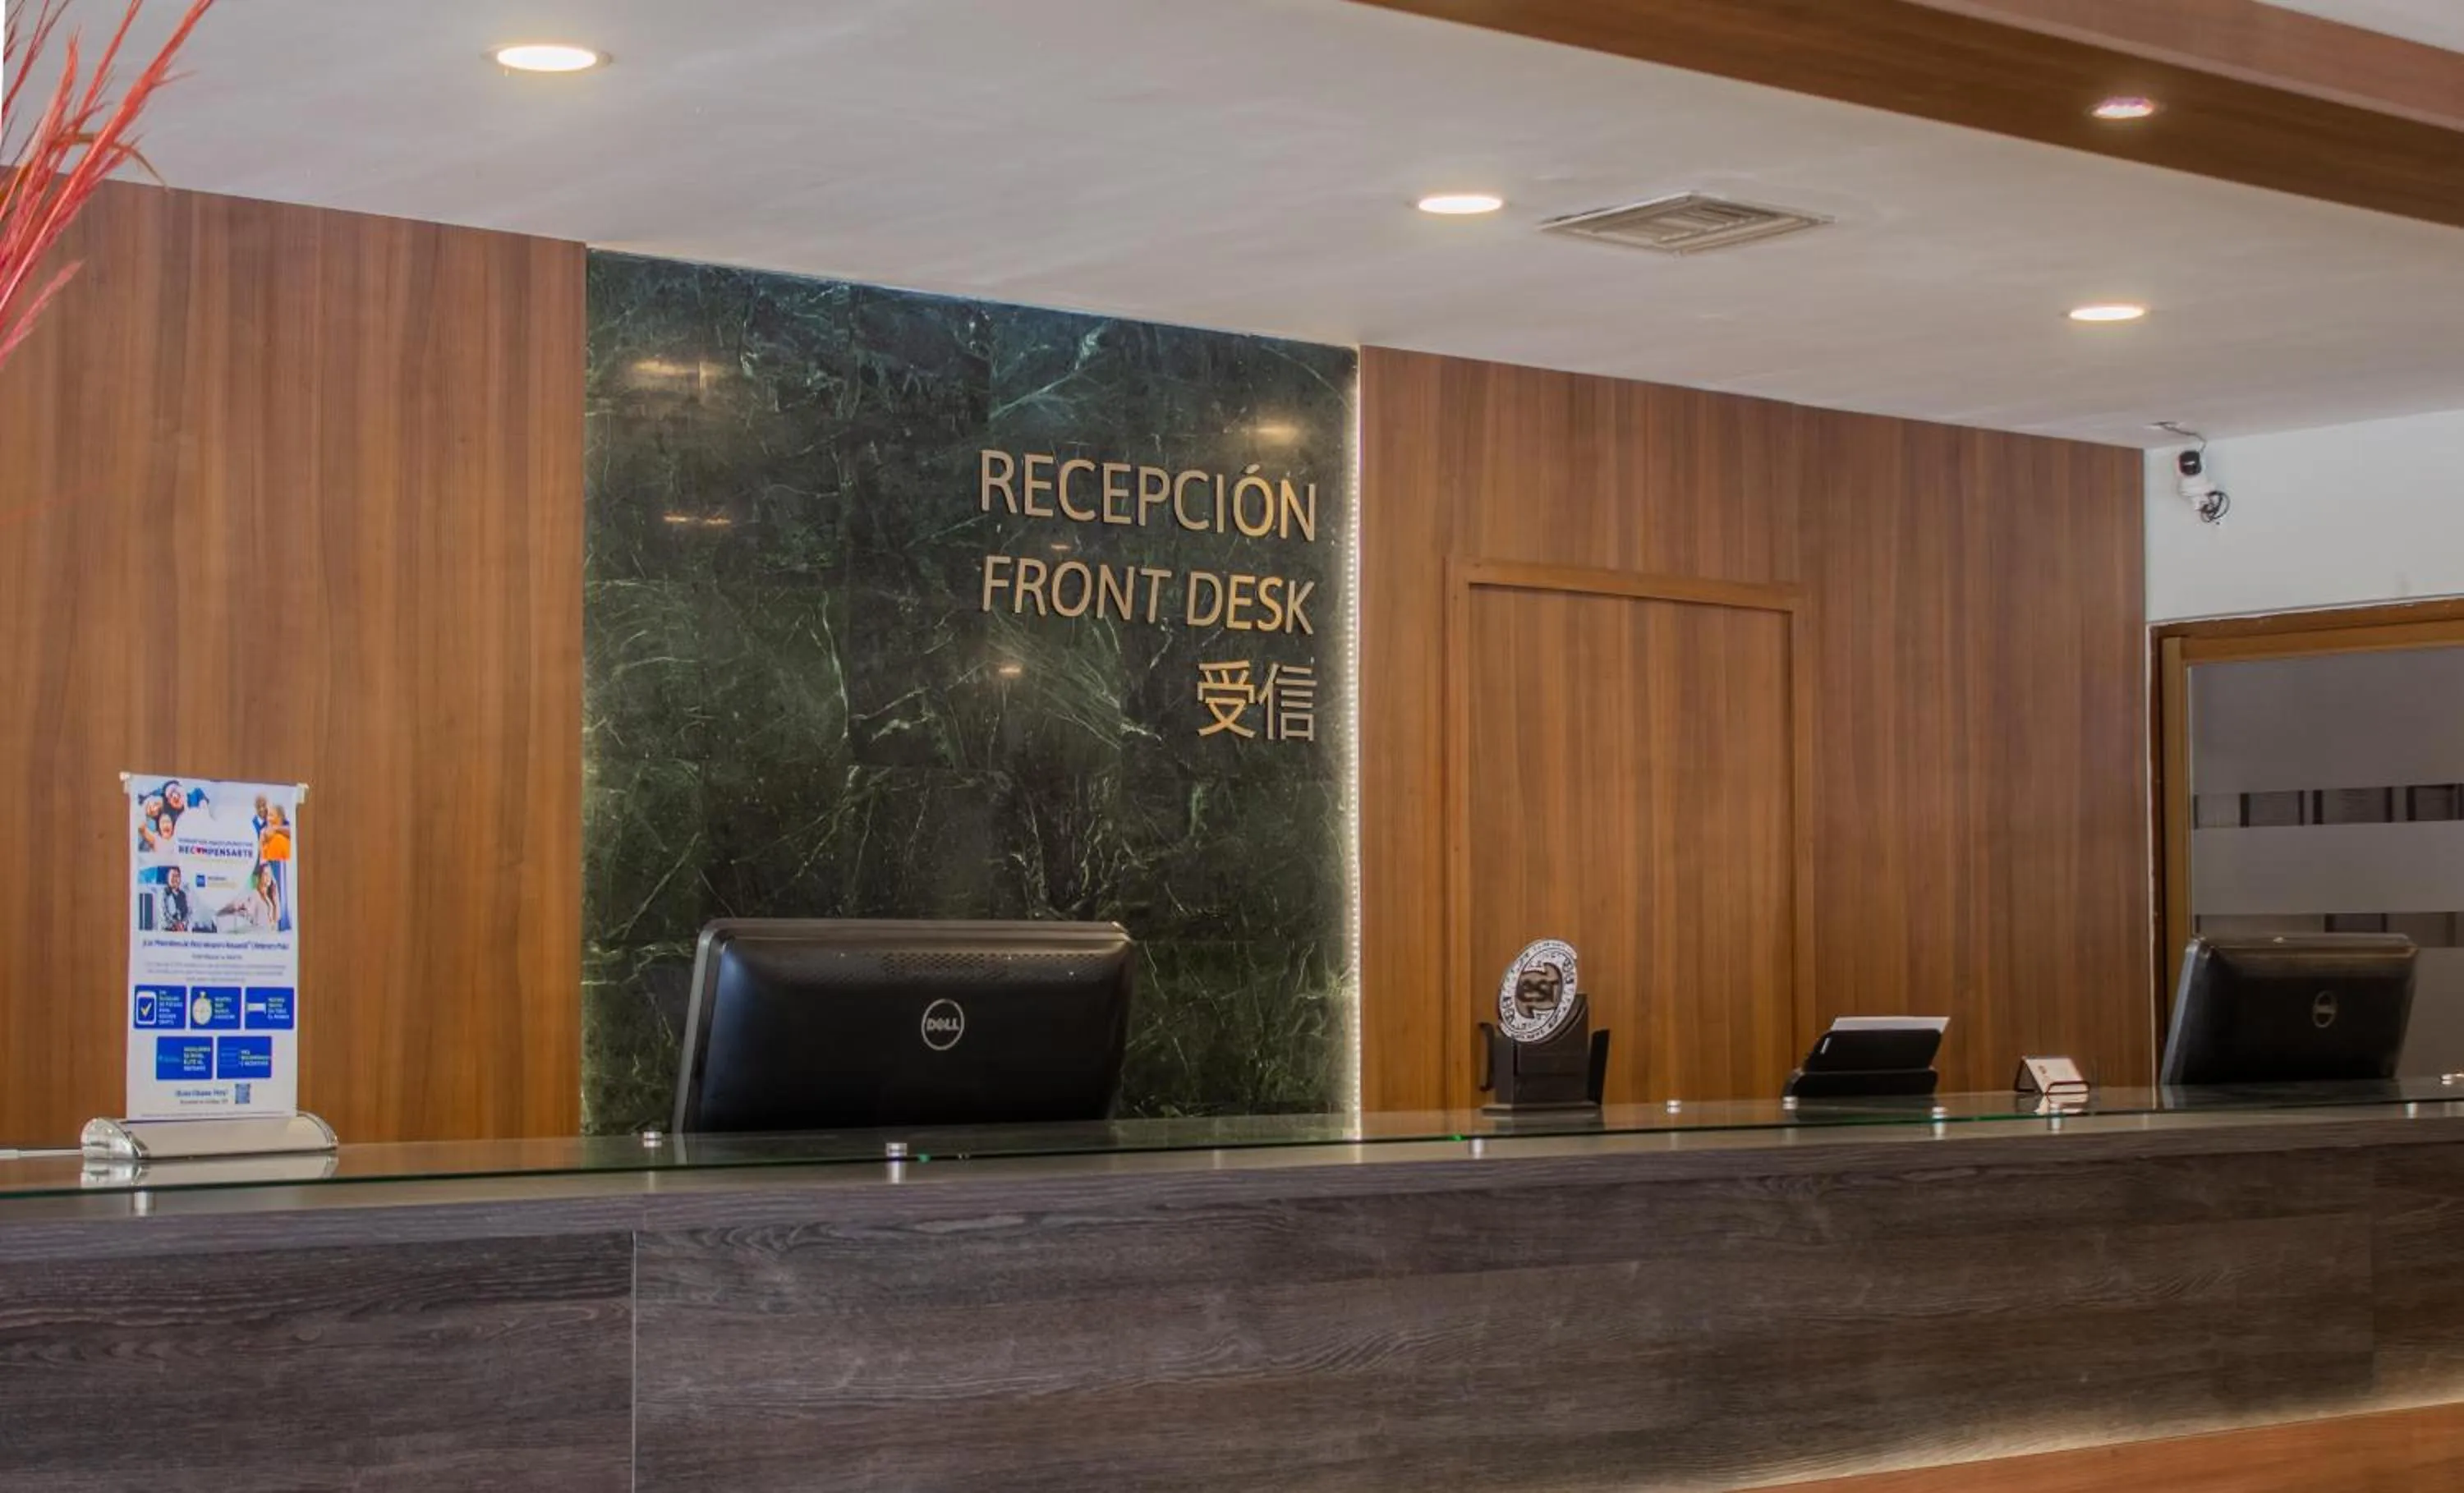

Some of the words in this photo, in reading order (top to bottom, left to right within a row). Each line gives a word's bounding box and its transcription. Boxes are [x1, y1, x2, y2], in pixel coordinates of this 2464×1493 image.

[981, 449, 1316, 542] RECEPCIÓN
[983, 555, 1173, 624] FRONT
[1187, 571, 1315, 636] DESK
[1197, 659, 1317, 741] 受信
[926, 1018, 960, 1031] DELL
